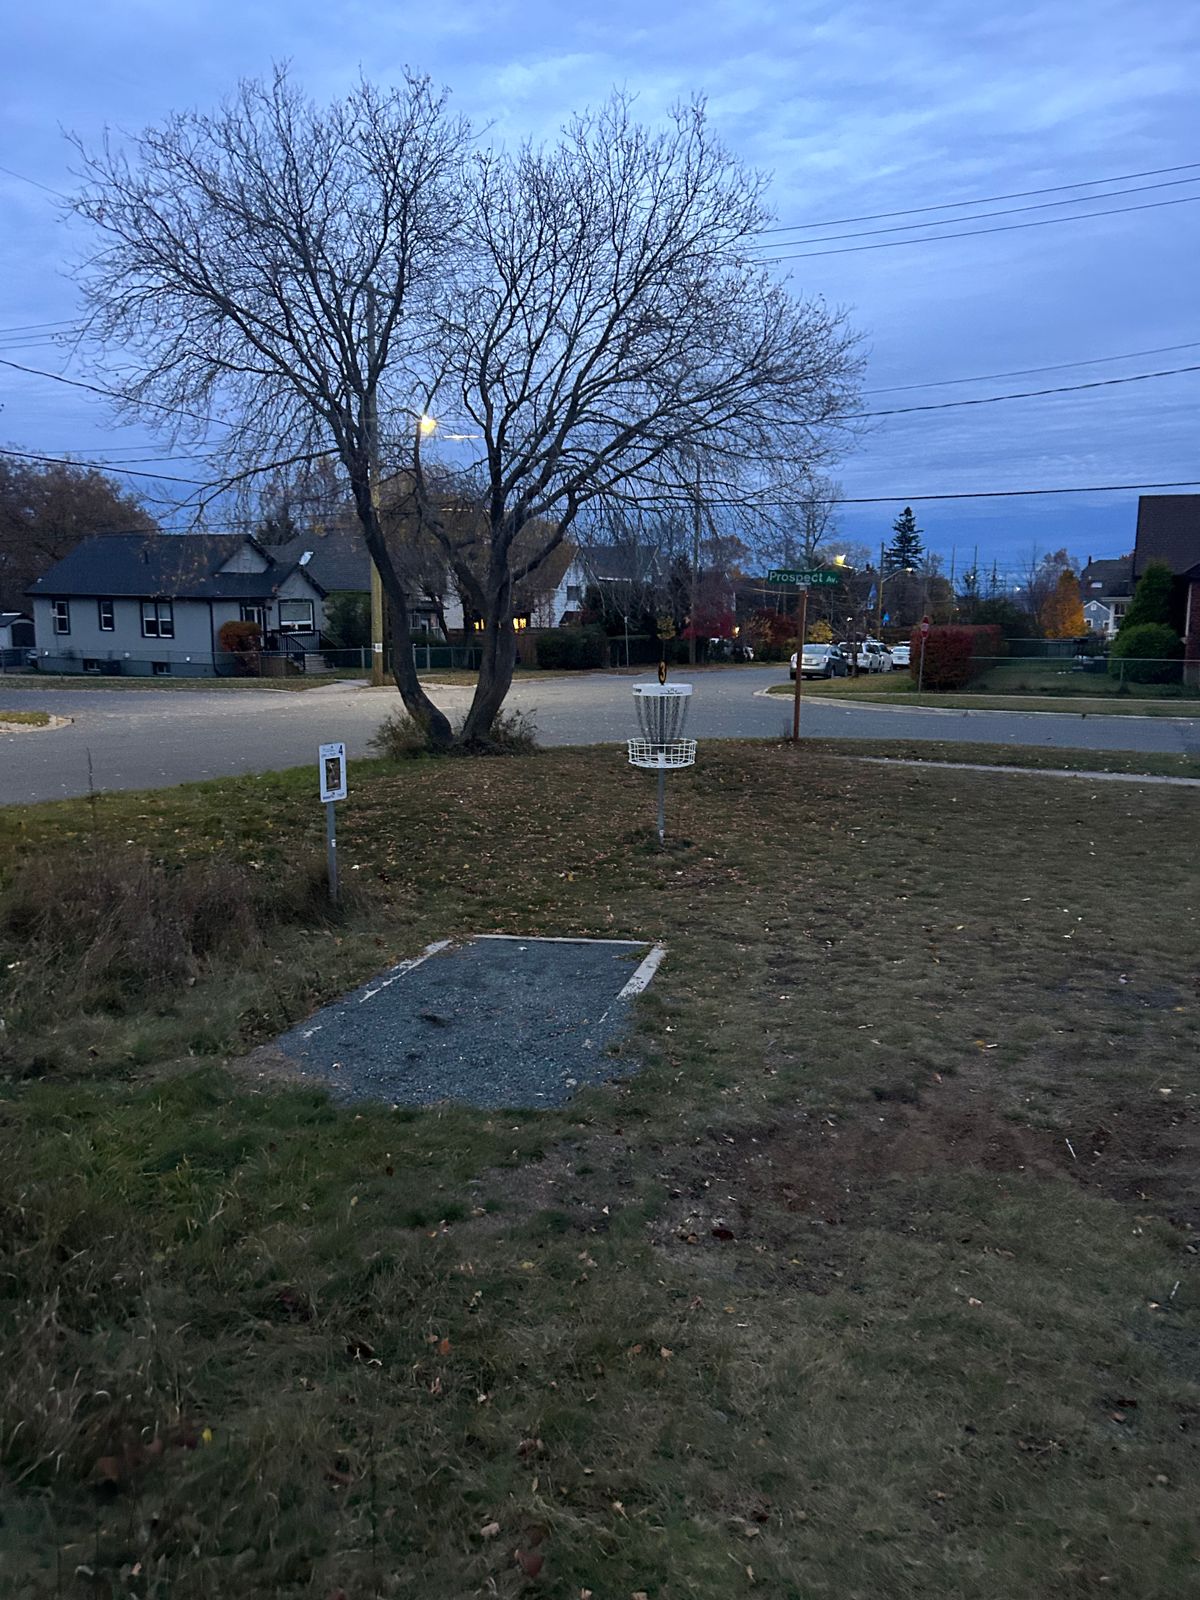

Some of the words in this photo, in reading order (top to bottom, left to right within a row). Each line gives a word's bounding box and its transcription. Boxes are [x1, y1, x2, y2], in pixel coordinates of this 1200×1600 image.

[769, 571, 823, 584] Prospect
[660, 661, 666, 681] 3
[338, 744, 343, 755] 4
